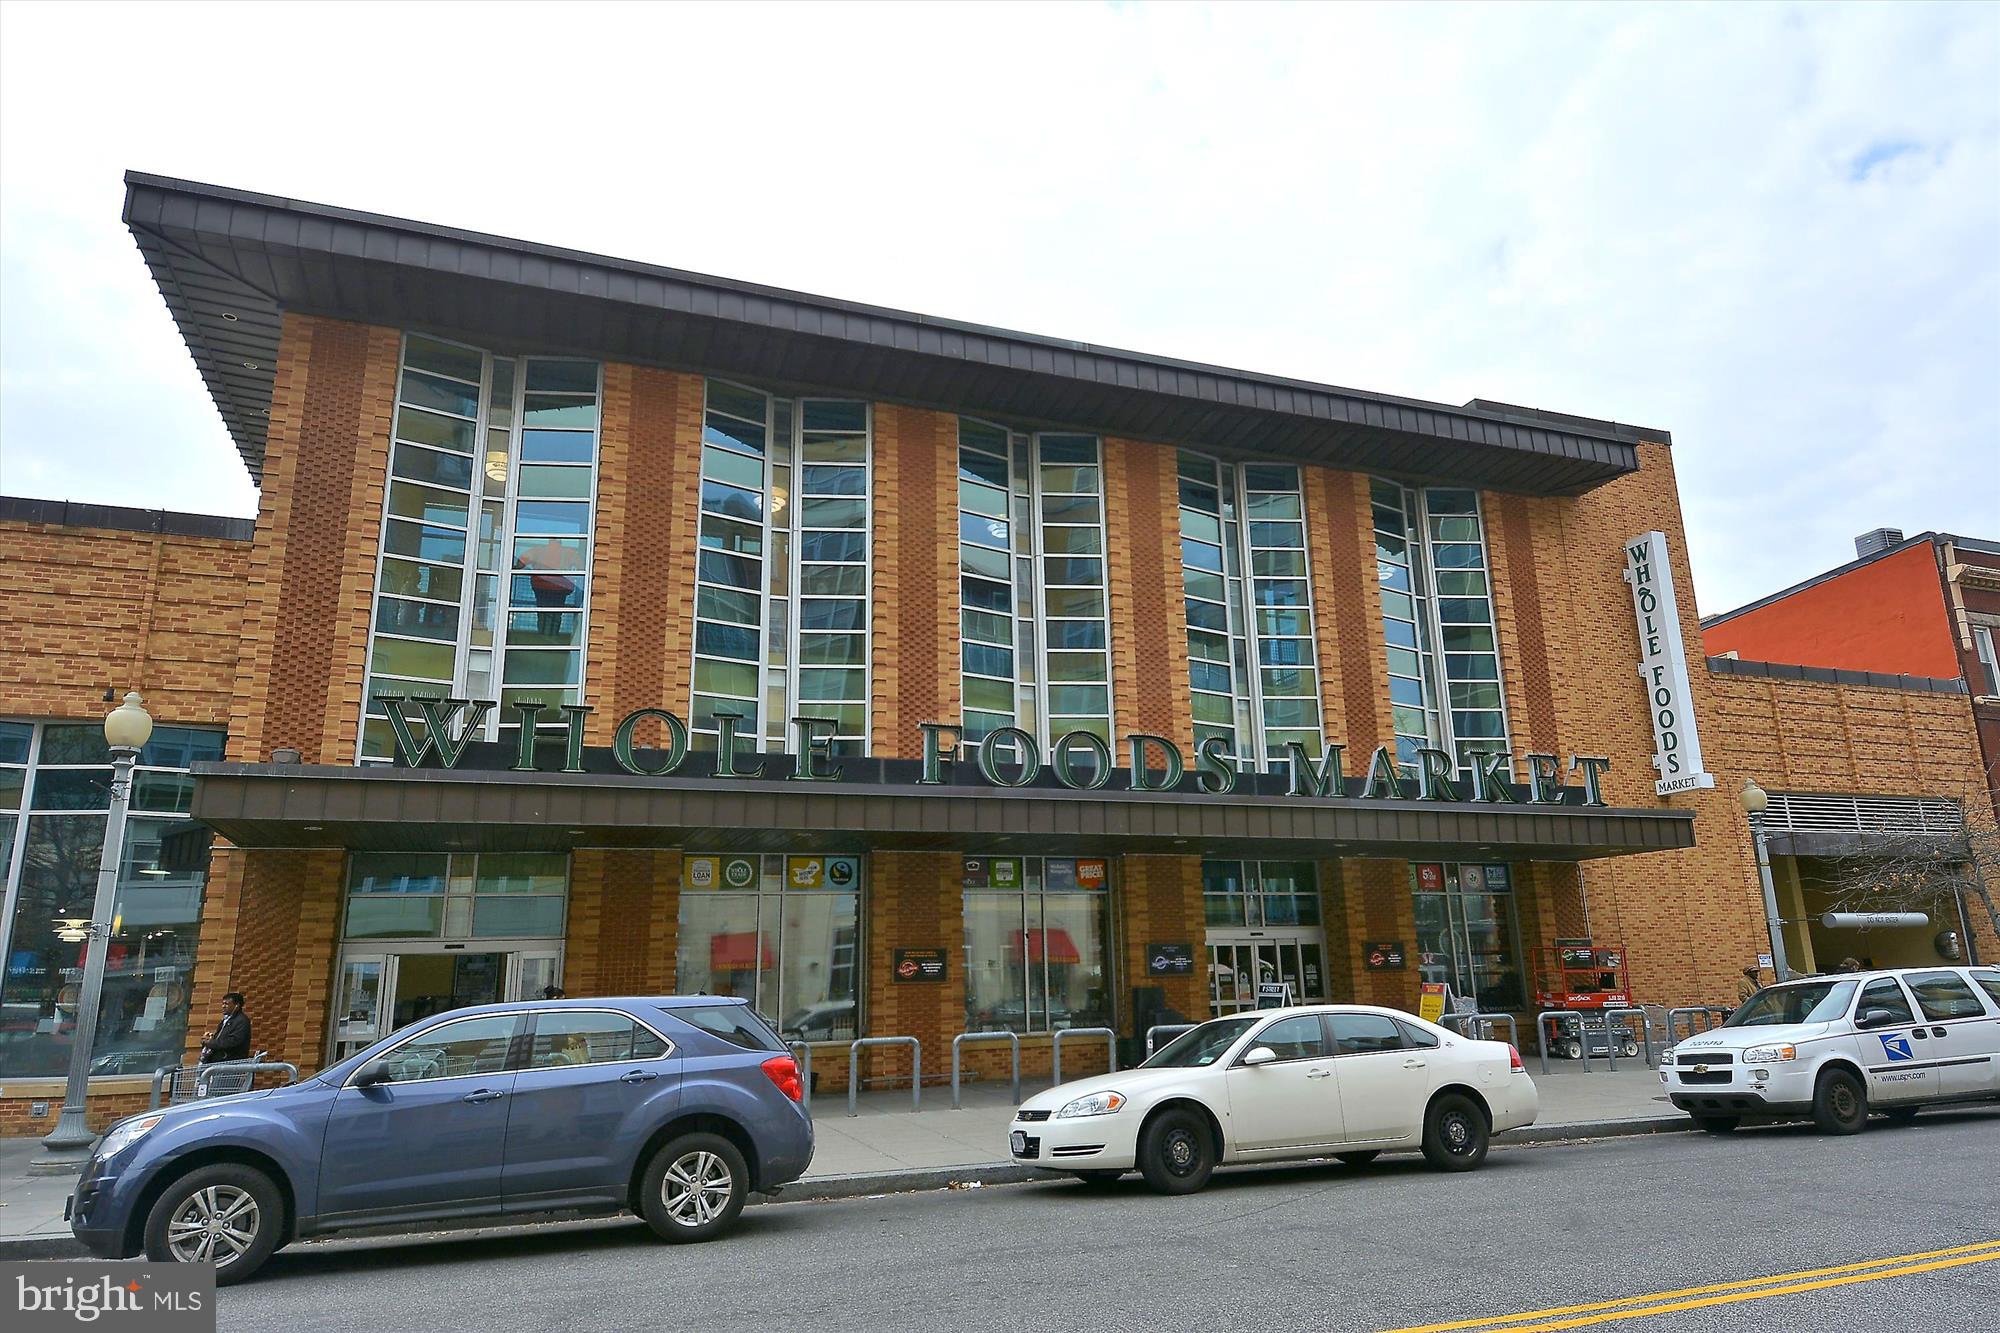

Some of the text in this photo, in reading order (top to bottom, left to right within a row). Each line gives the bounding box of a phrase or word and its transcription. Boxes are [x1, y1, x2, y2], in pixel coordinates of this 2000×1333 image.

[1652, 665, 1679, 774] FOODS
[378, 697, 1611, 808] WHOLE FOODS MARKET
[1658, 776, 1697, 793] MARKET
[692, 872, 712, 880] LOAN
[1568, 994, 1592, 1002] SKYJACK
[1880, 1072, 1926, 1082] www.usps.com
